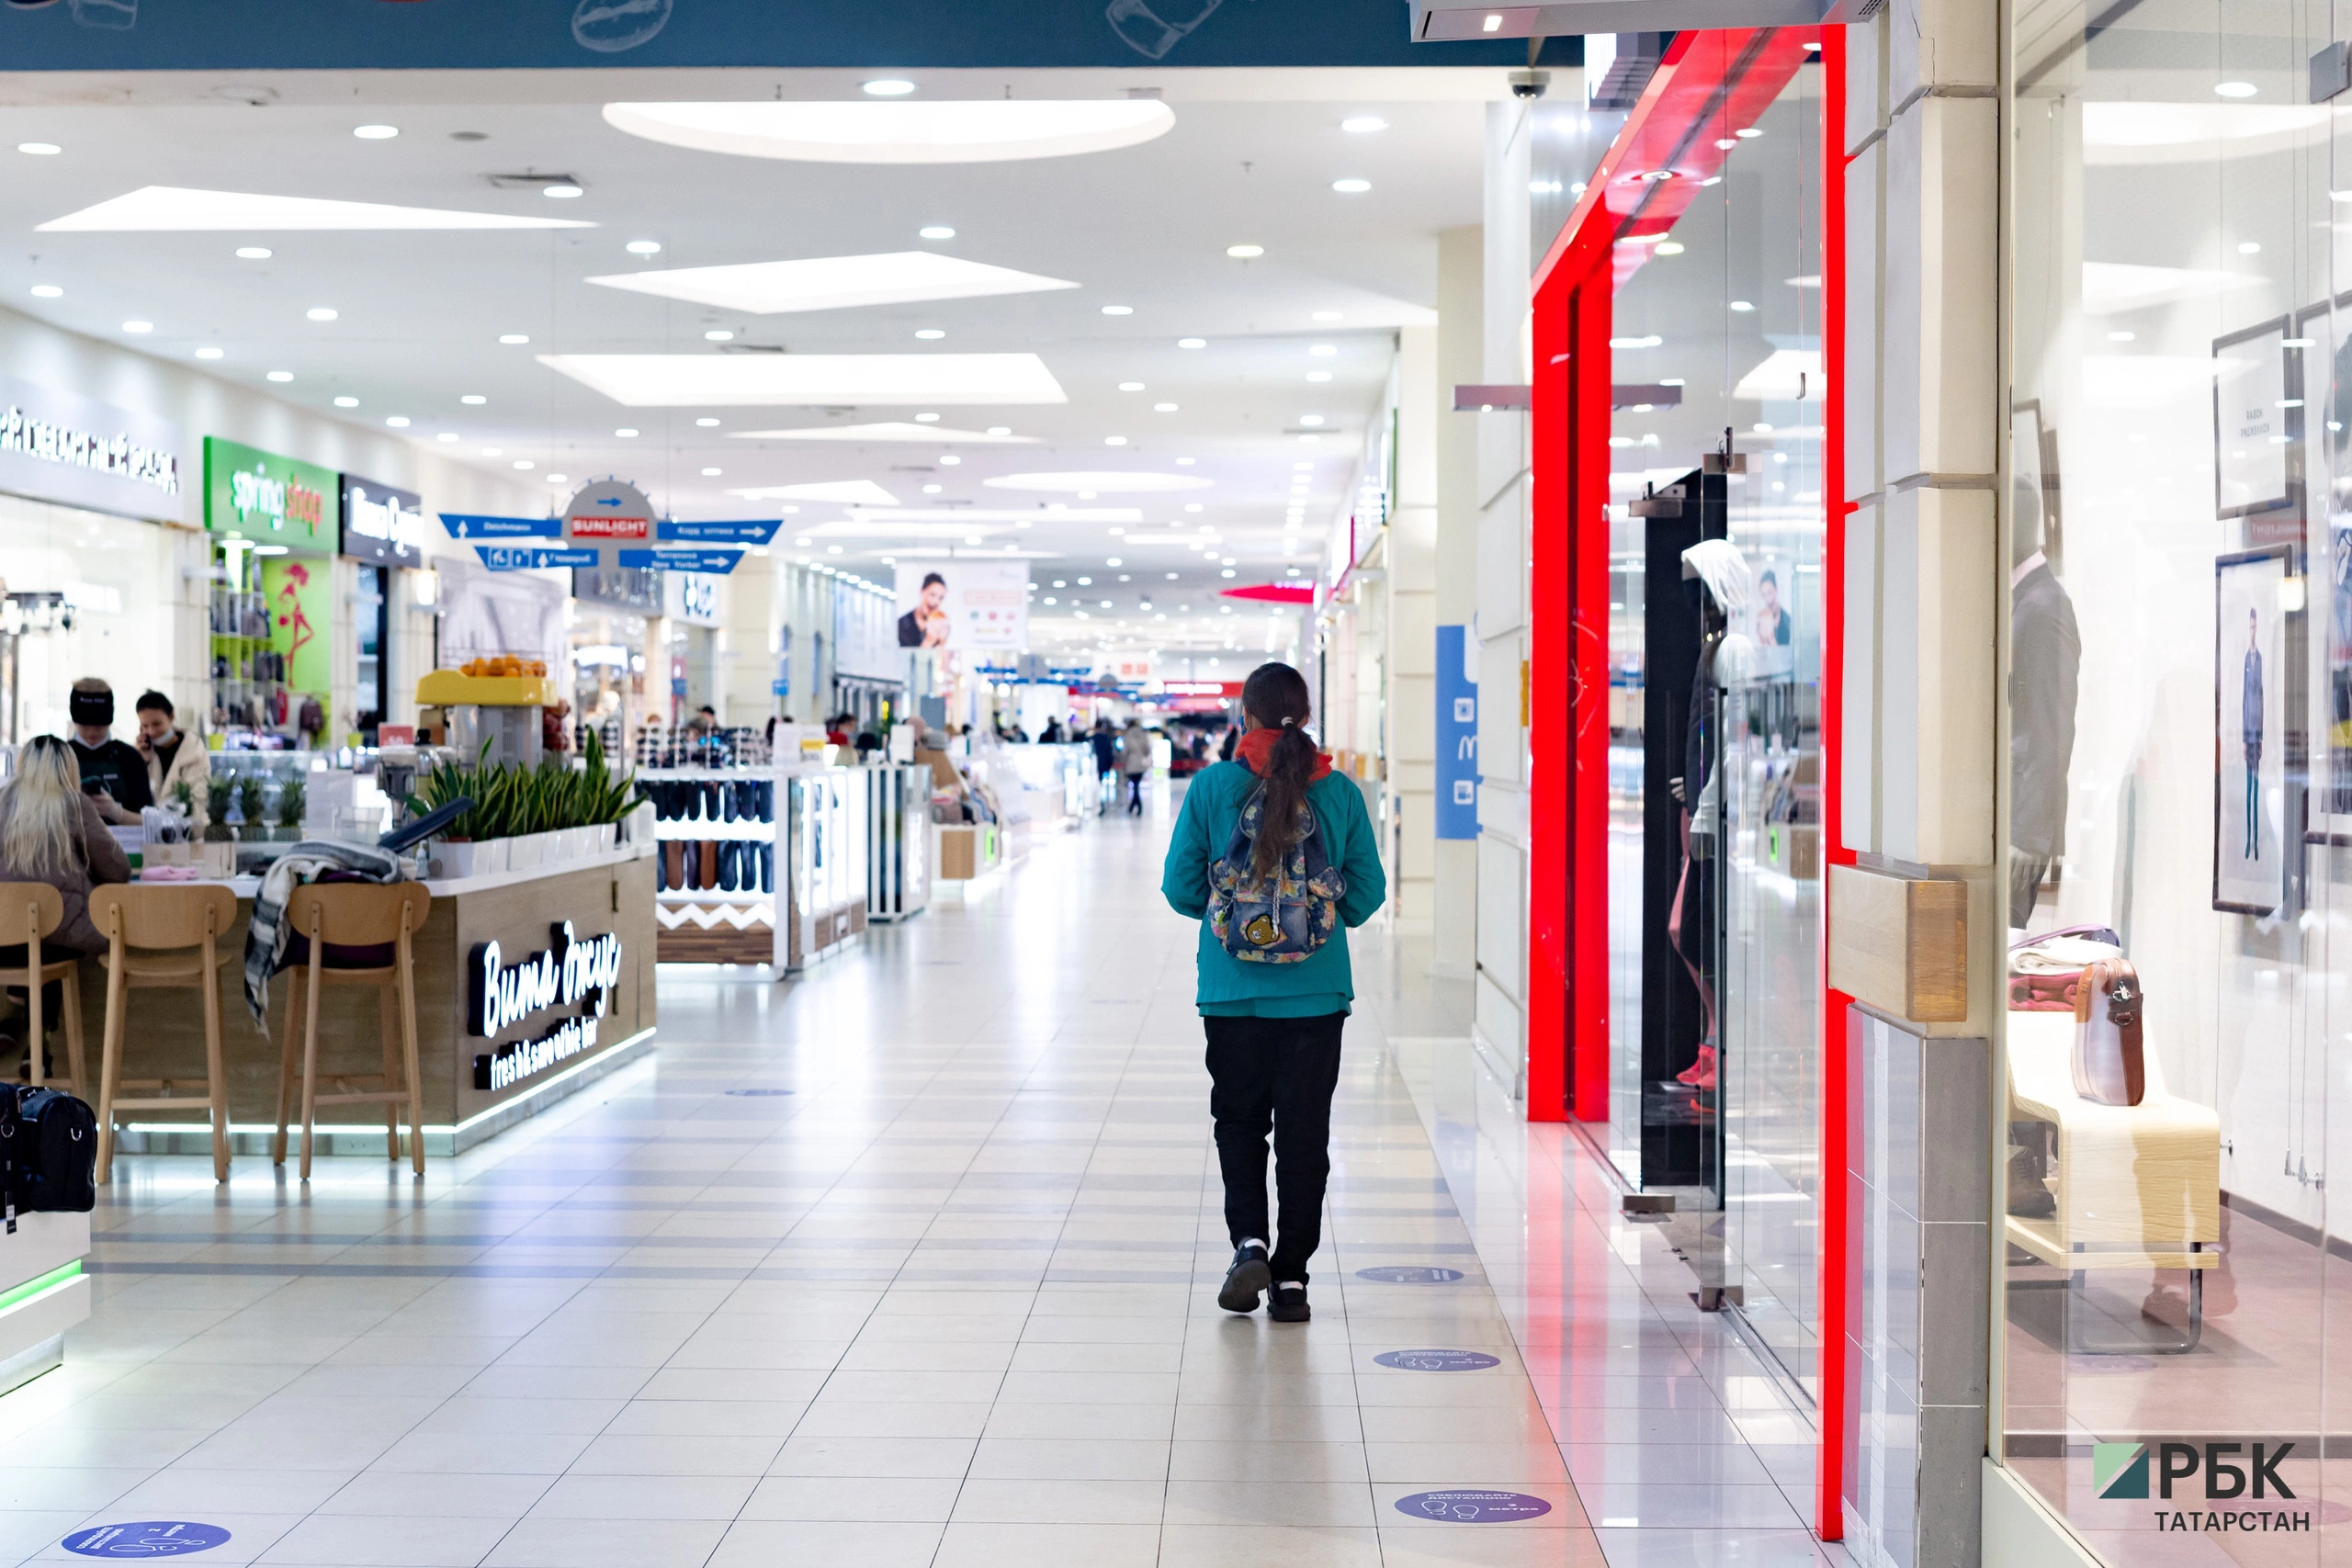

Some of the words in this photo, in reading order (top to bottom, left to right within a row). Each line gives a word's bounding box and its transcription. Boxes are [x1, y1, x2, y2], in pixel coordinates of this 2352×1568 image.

[232, 461, 284, 531] spring
[286, 473, 322, 536] shop
[573, 520, 647, 533] SUNLIGHT
[581, 1015, 598, 1049] bar
